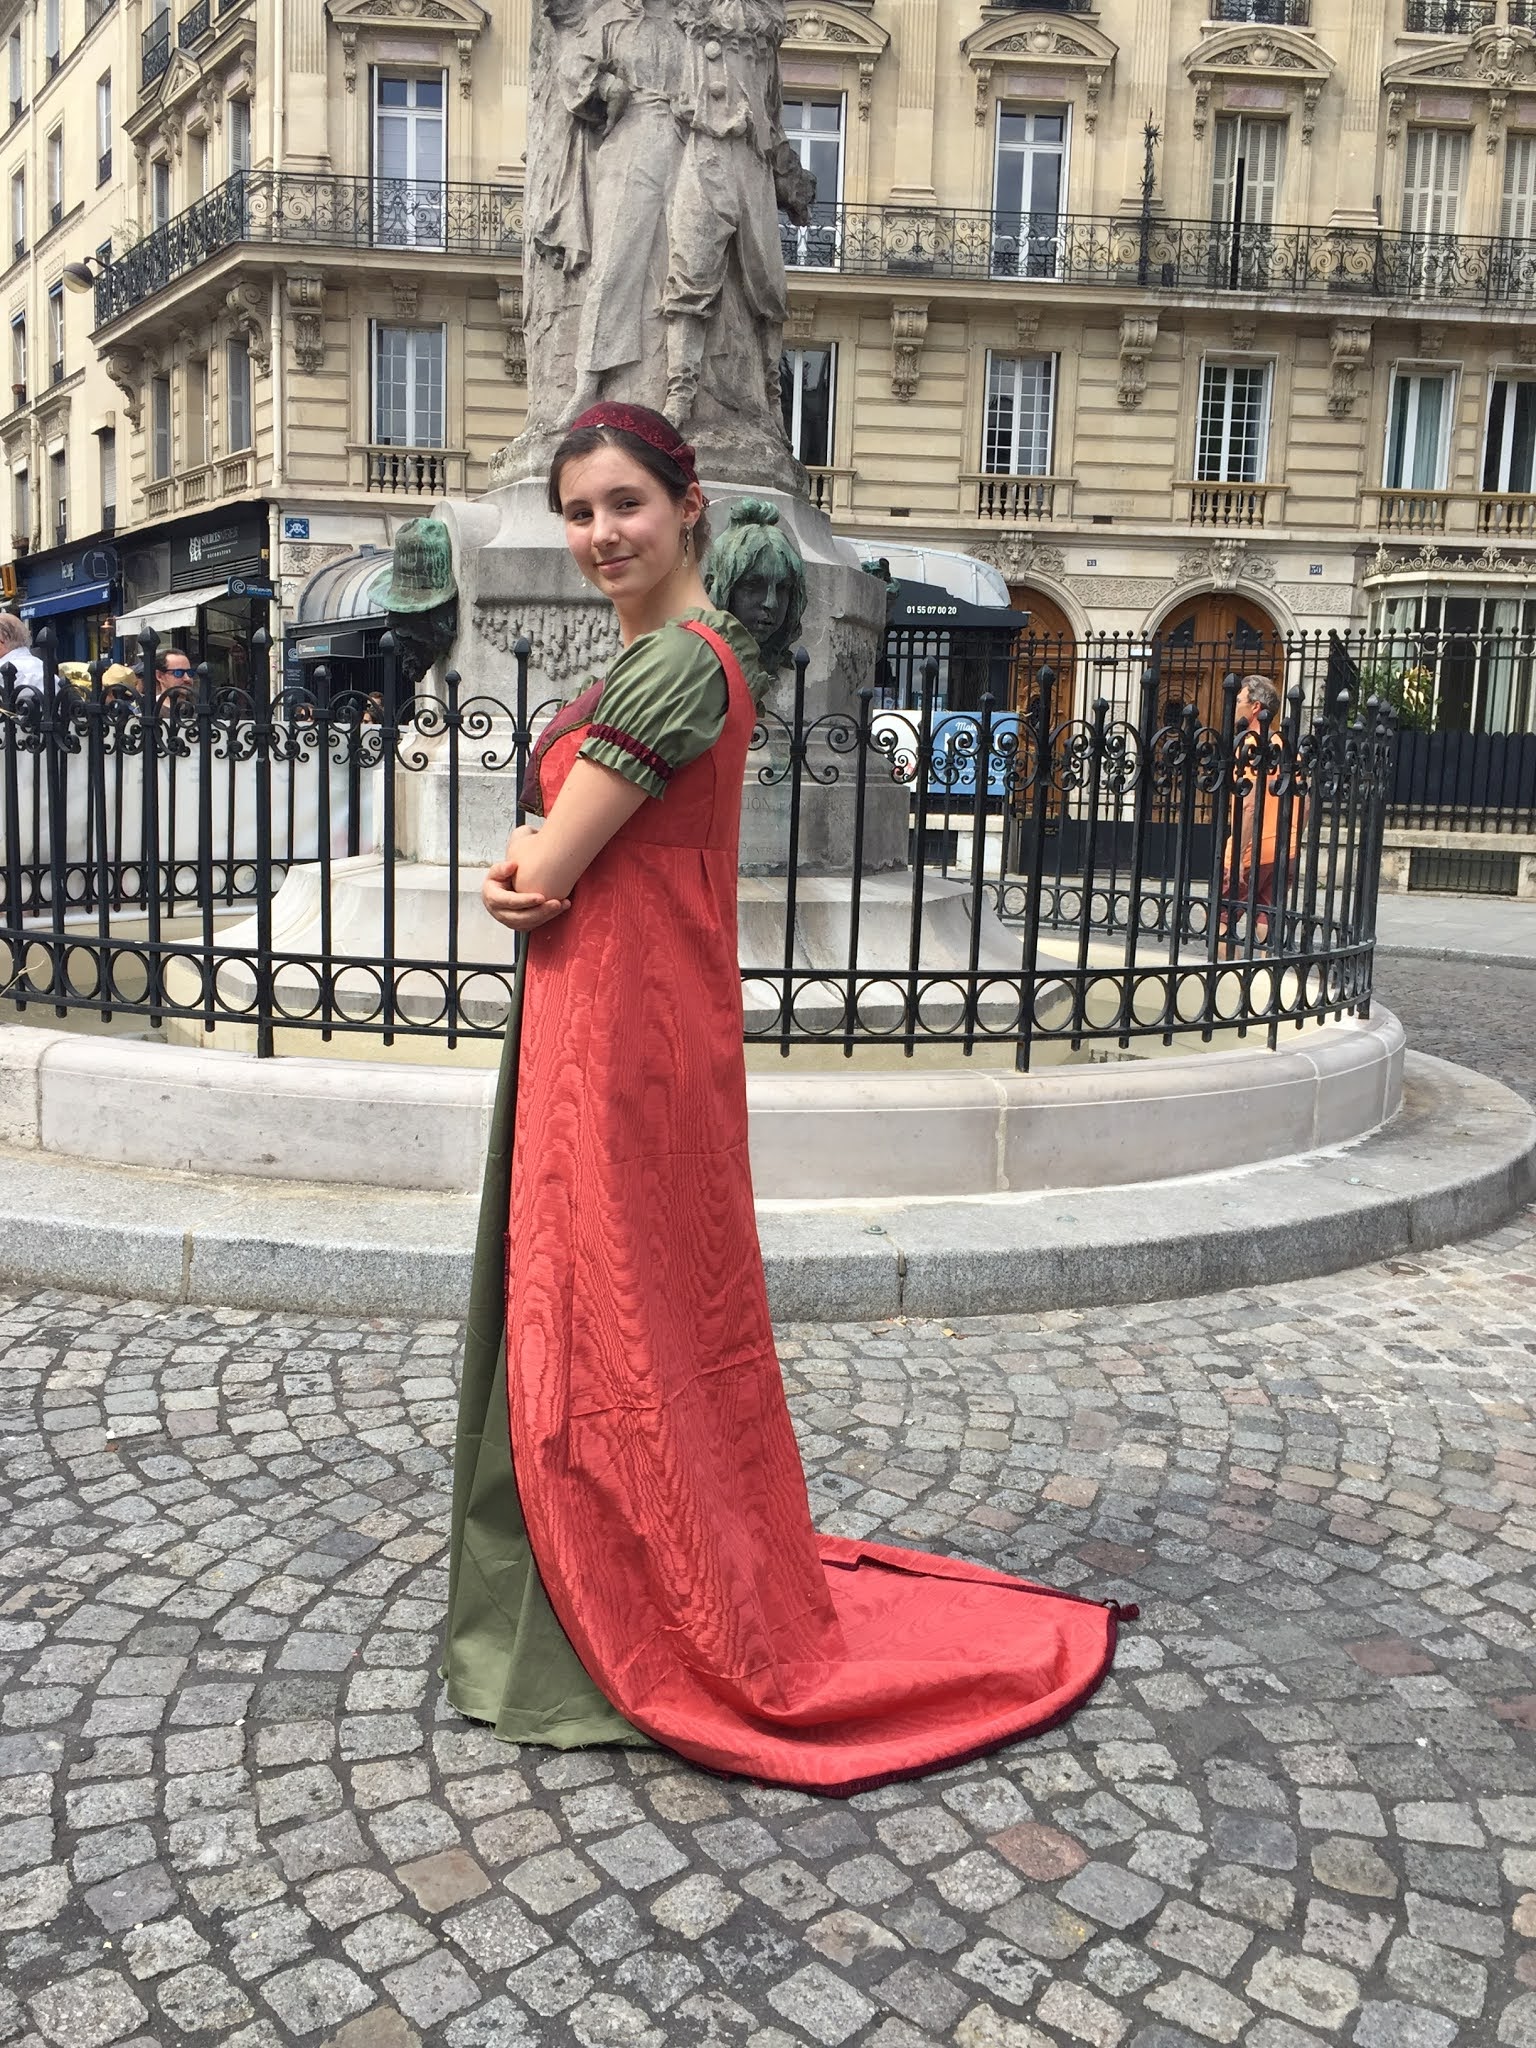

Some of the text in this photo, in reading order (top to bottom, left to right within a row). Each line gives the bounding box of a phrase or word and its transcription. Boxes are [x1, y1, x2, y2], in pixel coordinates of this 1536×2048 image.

[906, 605, 957, 615] 01 55 07 00 20
